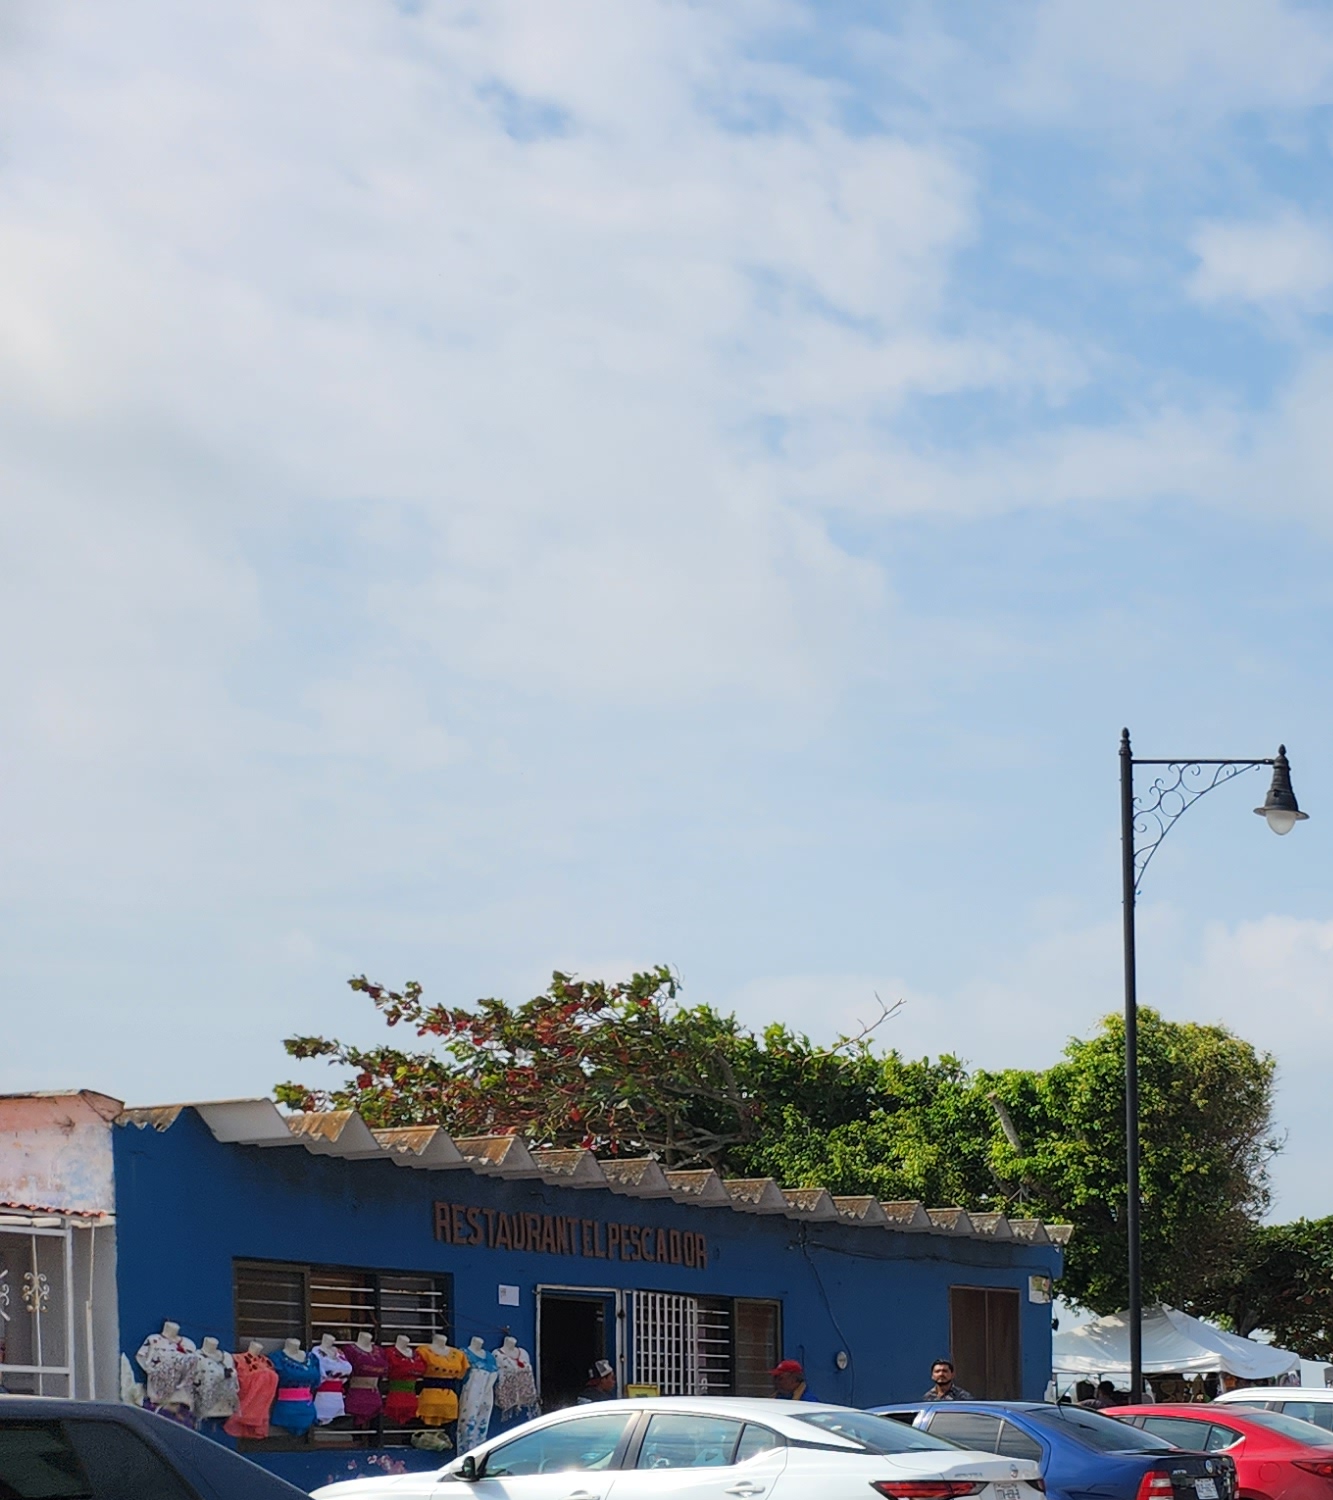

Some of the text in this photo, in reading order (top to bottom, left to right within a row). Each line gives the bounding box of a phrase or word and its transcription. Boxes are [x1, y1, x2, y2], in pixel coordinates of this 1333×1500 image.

[434, 1201, 708, 1270] RESTAURANT EL PESCADOR
